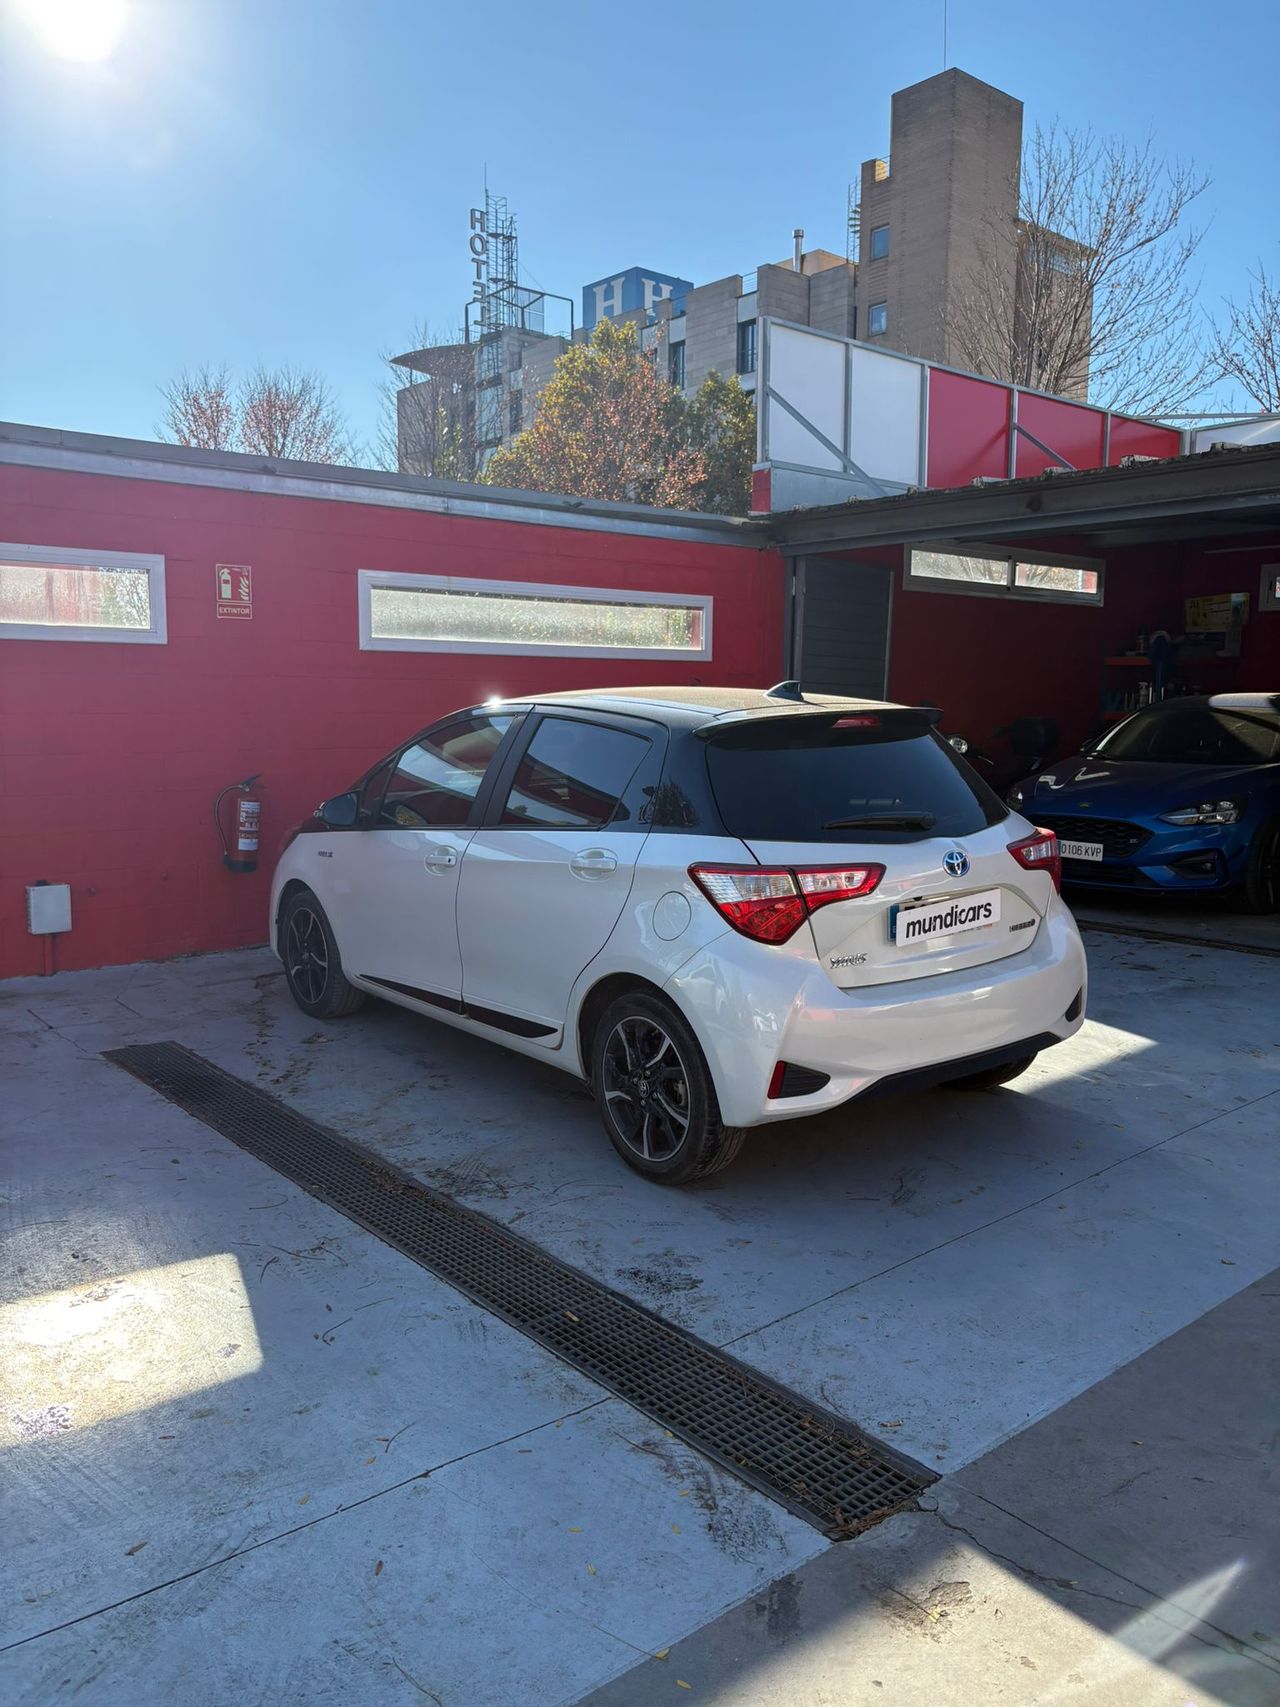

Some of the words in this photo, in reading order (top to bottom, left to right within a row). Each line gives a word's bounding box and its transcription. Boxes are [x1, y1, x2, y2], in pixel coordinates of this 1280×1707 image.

[593, 276, 625, 325] H
[219, 606, 250, 616] EXTINTOR
[1061, 843, 1083, 856] 0106
[1084, 846, 1102, 858] KVP
[905, 902, 992, 938] mundicars
